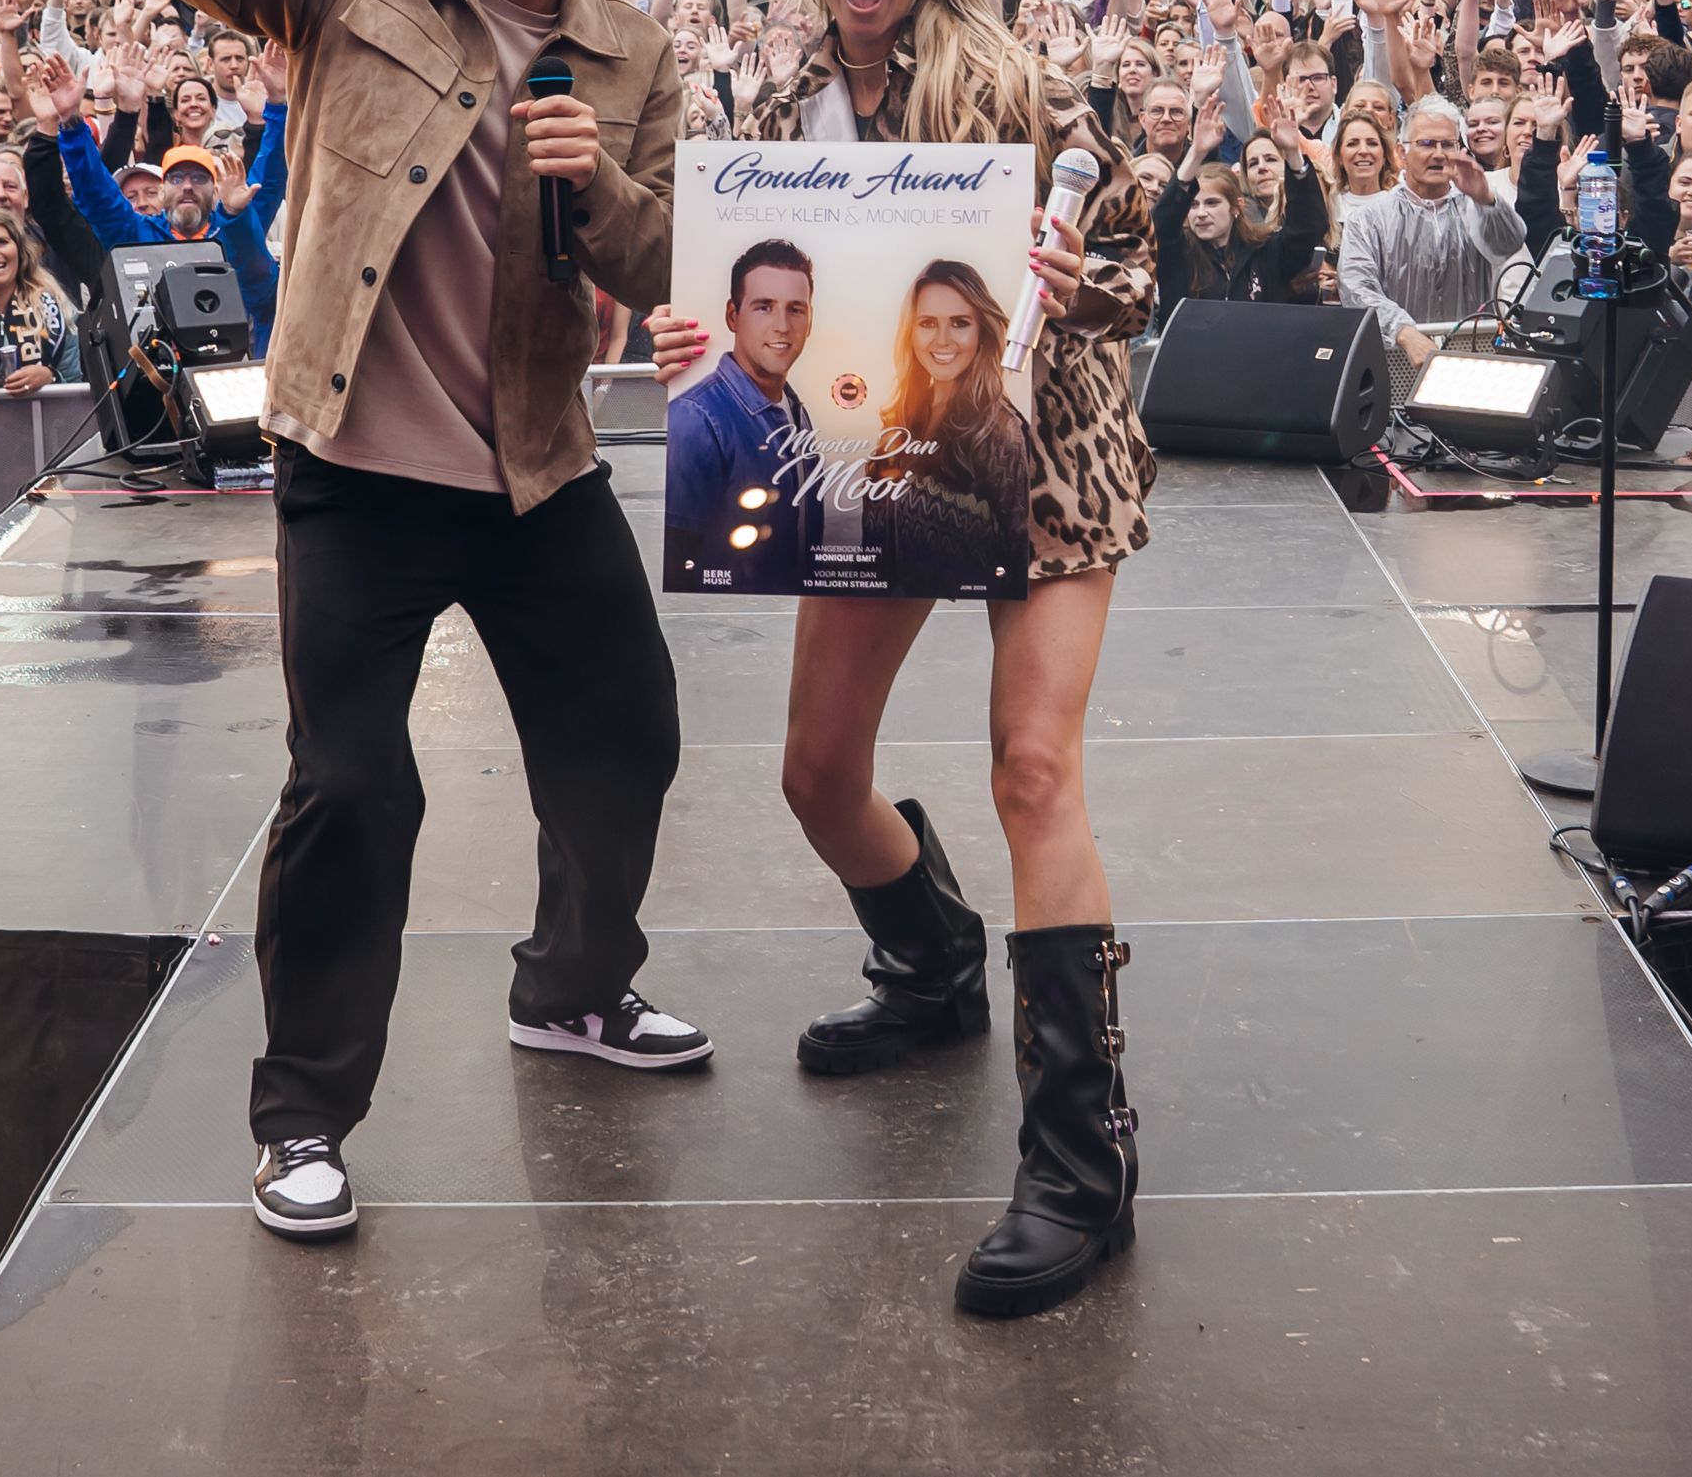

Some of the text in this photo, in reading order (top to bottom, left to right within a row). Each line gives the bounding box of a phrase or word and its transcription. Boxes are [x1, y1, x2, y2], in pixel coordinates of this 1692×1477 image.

[714, 151, 995, 203] Gouden Award
[716, 205, 993, 226] WESLEY KLEIN & MONIQUE SMIT
[766, 424, 939, 460] Mooier Dan
[772, 452, 913, 512] Mooi
[810, 545, 882, 554] AANGEBODEN AAN
[814, 553, 877, 563] MONIQUE SMIT
[703, 569, 732, 579] BERK
[814, 570, 877, 579] VOOR MEER DAN
[703, 577, 732, 586] MUSIC
[803, 579, 888, 589] 10 MILJOEN STREAMS
